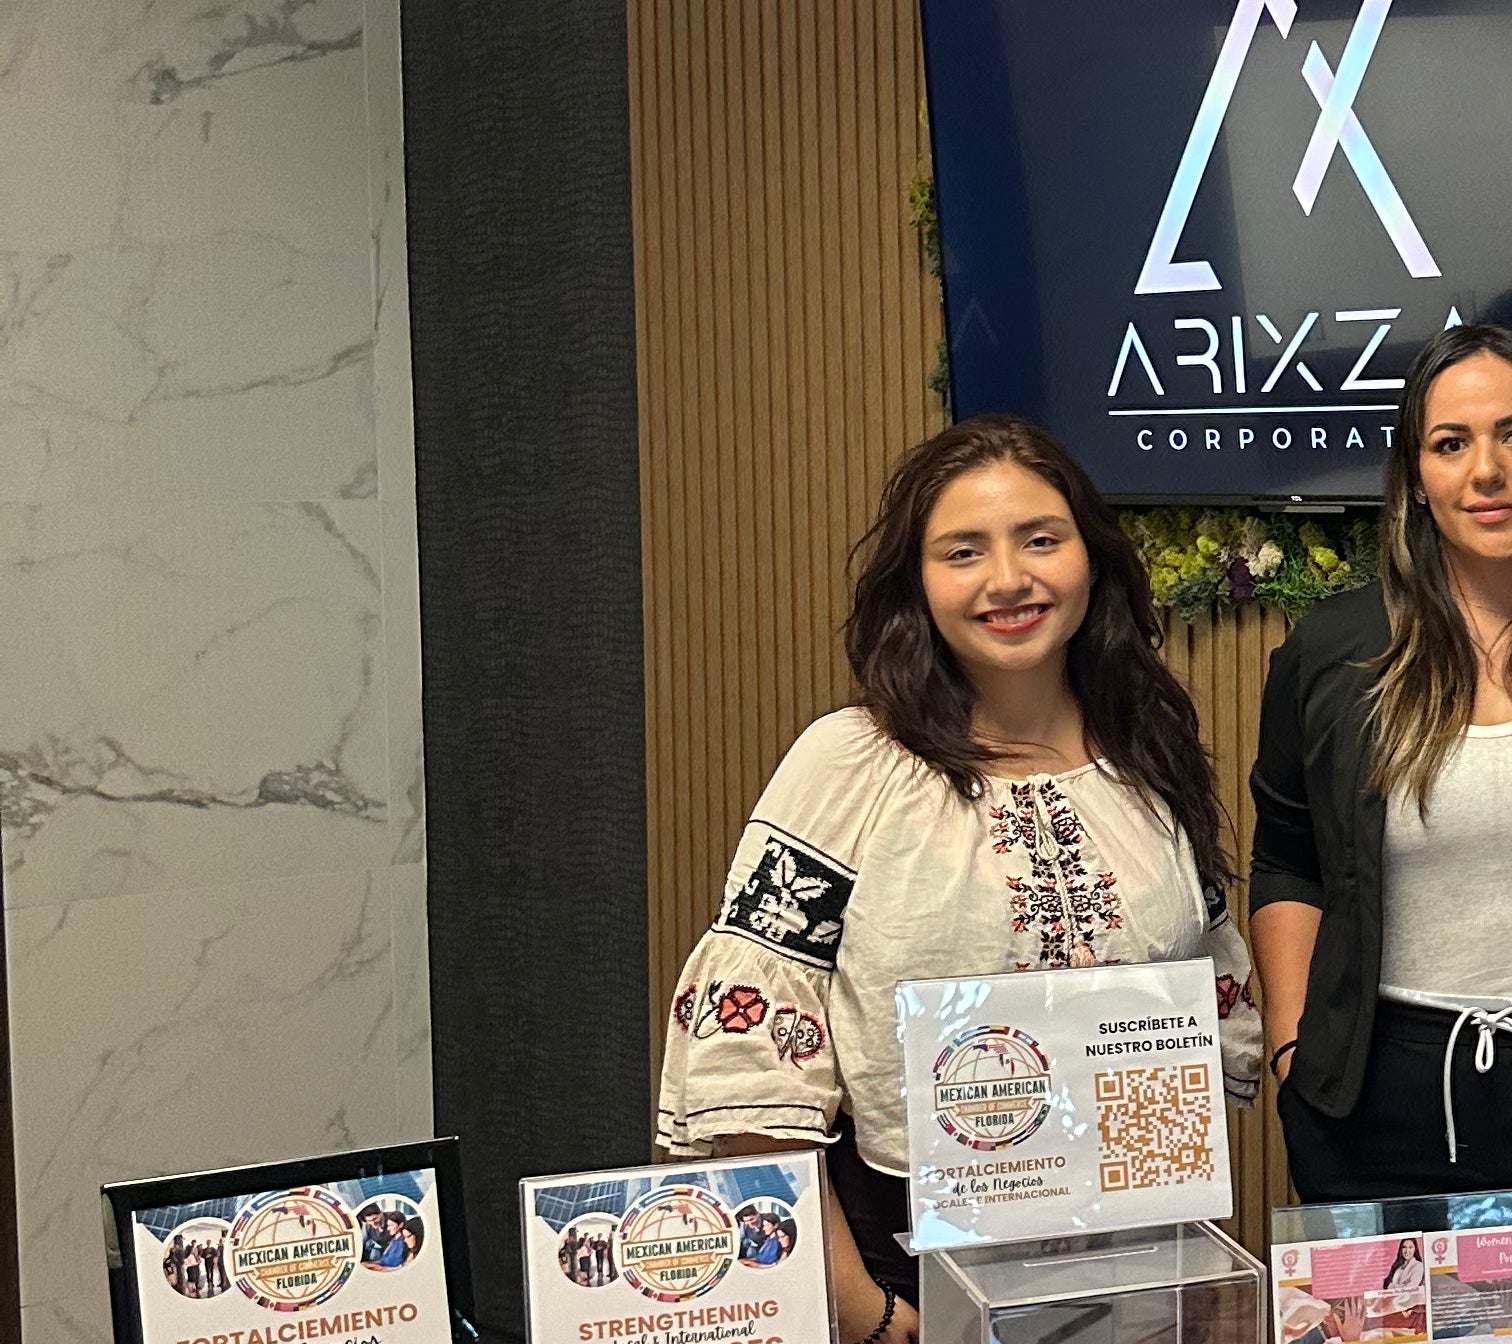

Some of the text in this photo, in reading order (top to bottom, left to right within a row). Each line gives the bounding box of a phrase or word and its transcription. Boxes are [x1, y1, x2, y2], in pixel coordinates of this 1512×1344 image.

[1107, 305, 1466, 397] ARIXZ
[1136, 425, 1396, 451] CORPORAT
[1099, 1016, 1198, 1035] SUSCRÍBETE A
[1085, 1032, 1214, 1057] NUESTRO BOLETÍN
[940, 1080, 1047, 1103] MEXICAN AMERICAN
[975, 1113, 1015, 1128] FLORIDA
[933, 1156, 1066, 1181] ORTALCIEMIENTO
[952, 1176, 1044, 1197] de los Negocios
[985, 1186, 1071, 1204] INTERNACIONAL
[238, 1238, 350, 1267] MEXICAN AMERICAN
[627, 1236, 728, 1259] MEXICAN AMERICAN
[1476, 1236, 1512, 1248] Women
[276, 1273, 318, 1290] FLORIDA
[660, 1268, 698, 1281] FLORIDA
[579, 1300, 779, 1342] STRENGTHENING
